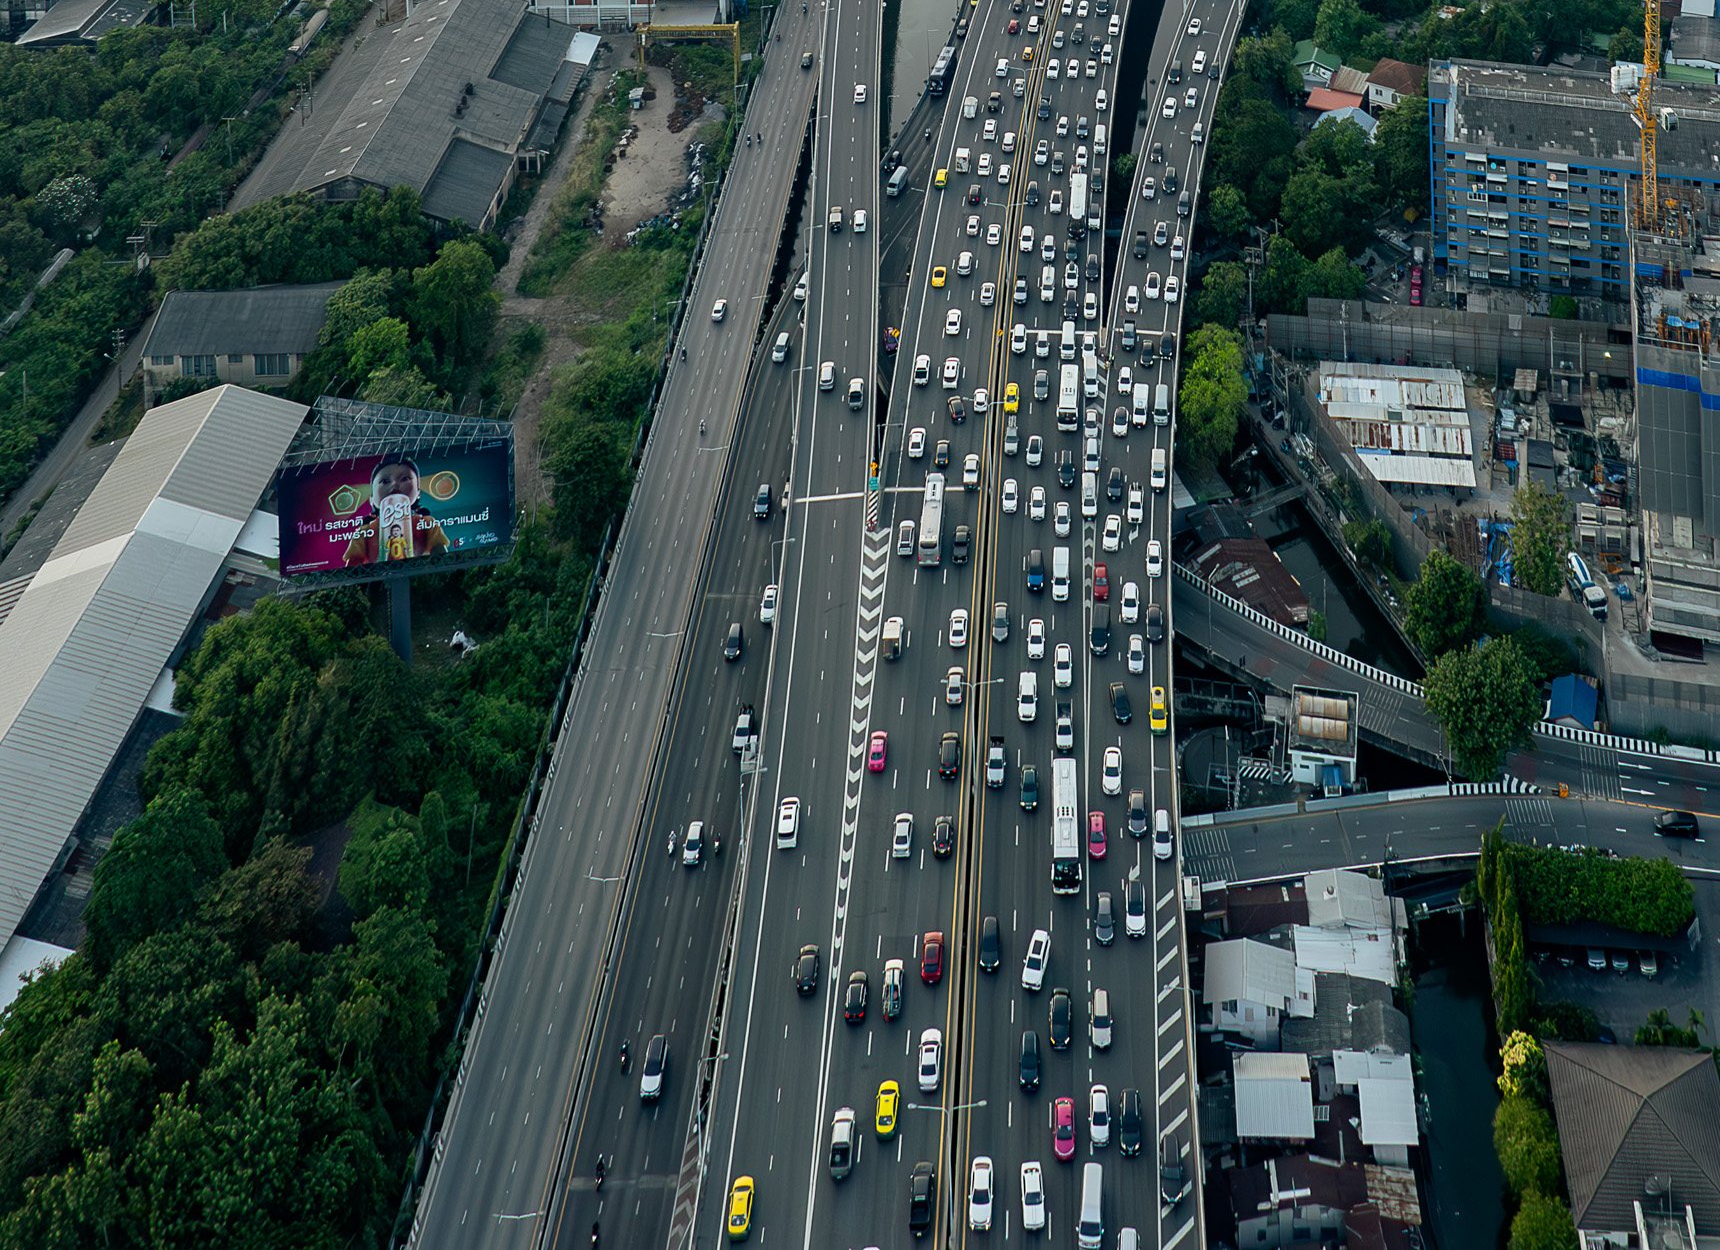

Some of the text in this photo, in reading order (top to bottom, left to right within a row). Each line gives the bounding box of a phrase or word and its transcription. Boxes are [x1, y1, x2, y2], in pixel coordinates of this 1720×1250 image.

[297, 515, 364, 535] ใหม่ รสชาติ
[329, 528, 375, 543] มะพร้าว
